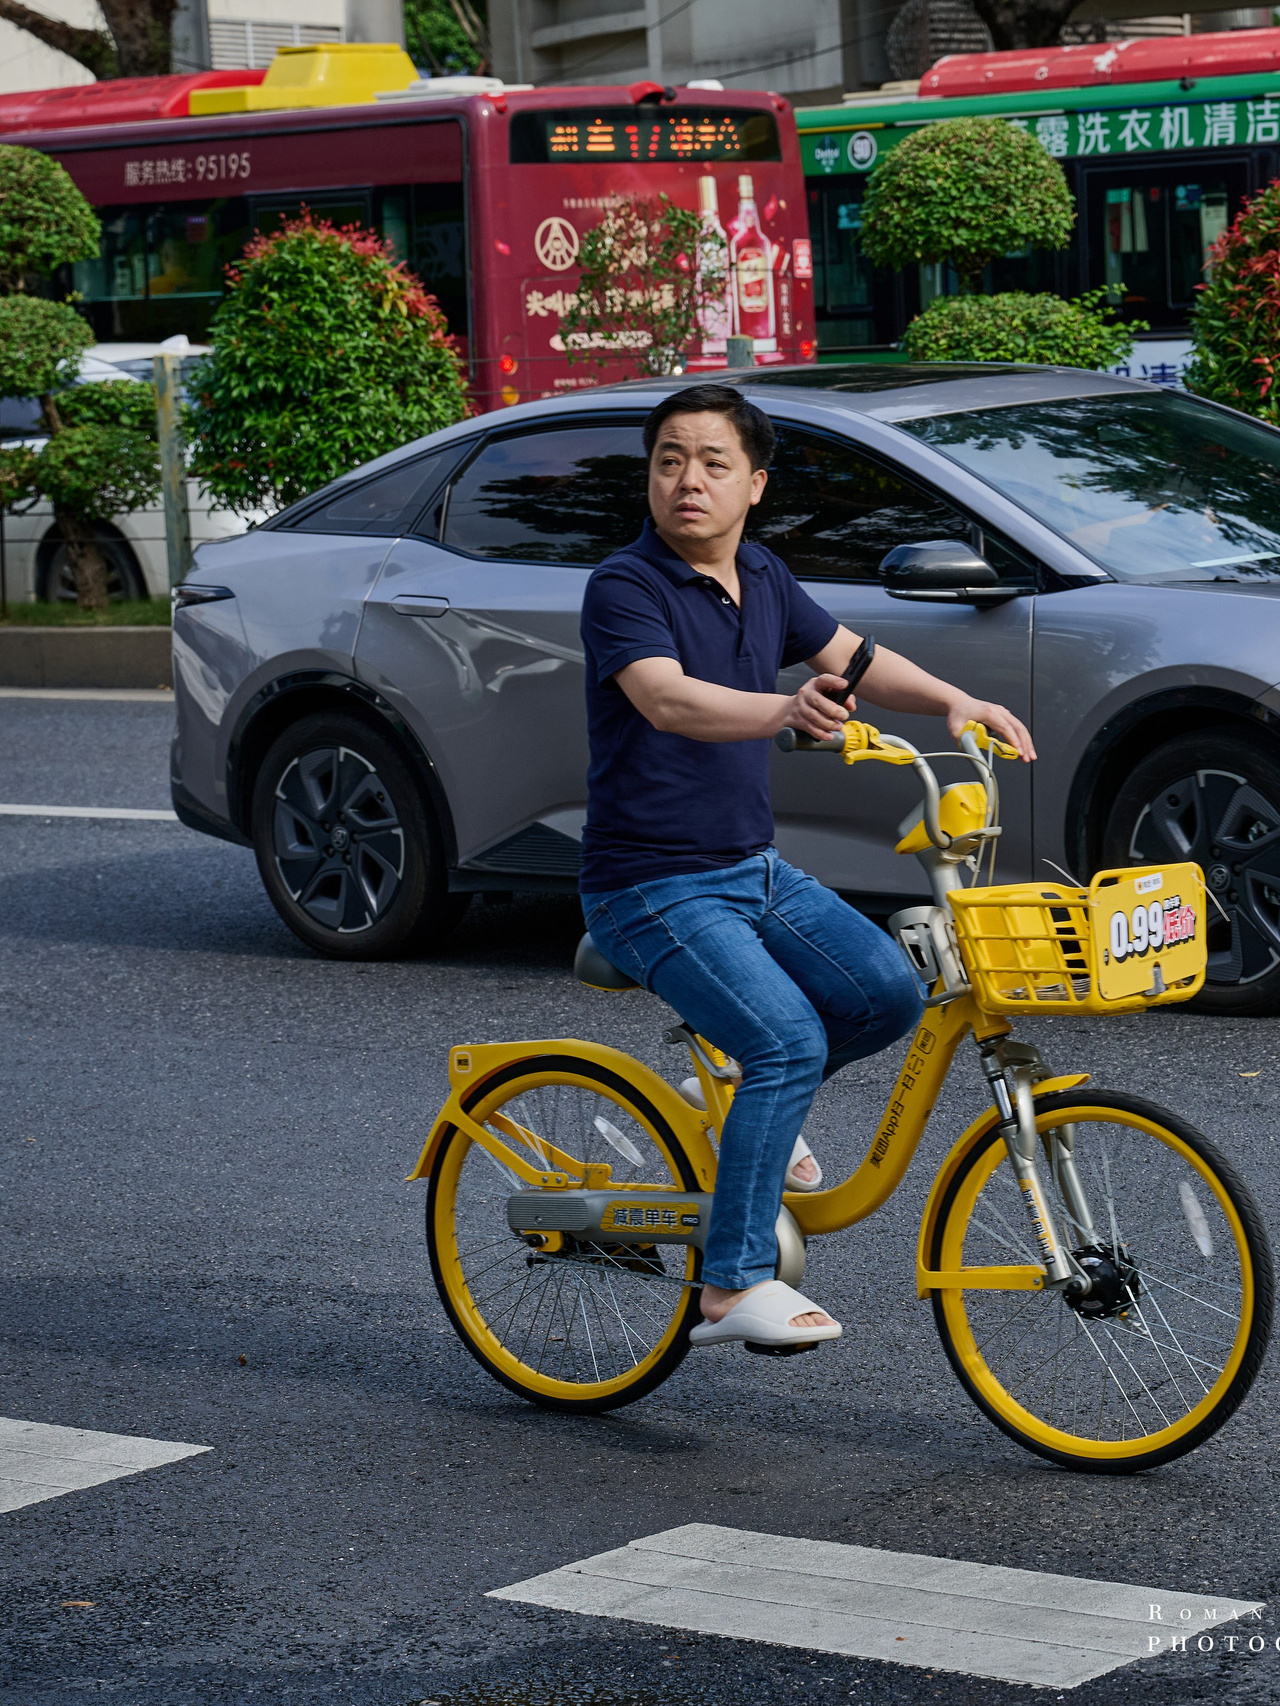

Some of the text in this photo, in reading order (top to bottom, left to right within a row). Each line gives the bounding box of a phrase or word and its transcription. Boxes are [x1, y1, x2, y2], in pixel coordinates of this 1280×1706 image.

[1110, 901, 1163, 959] 0.99
[613, 1207, 678, 1228] 减震单车
